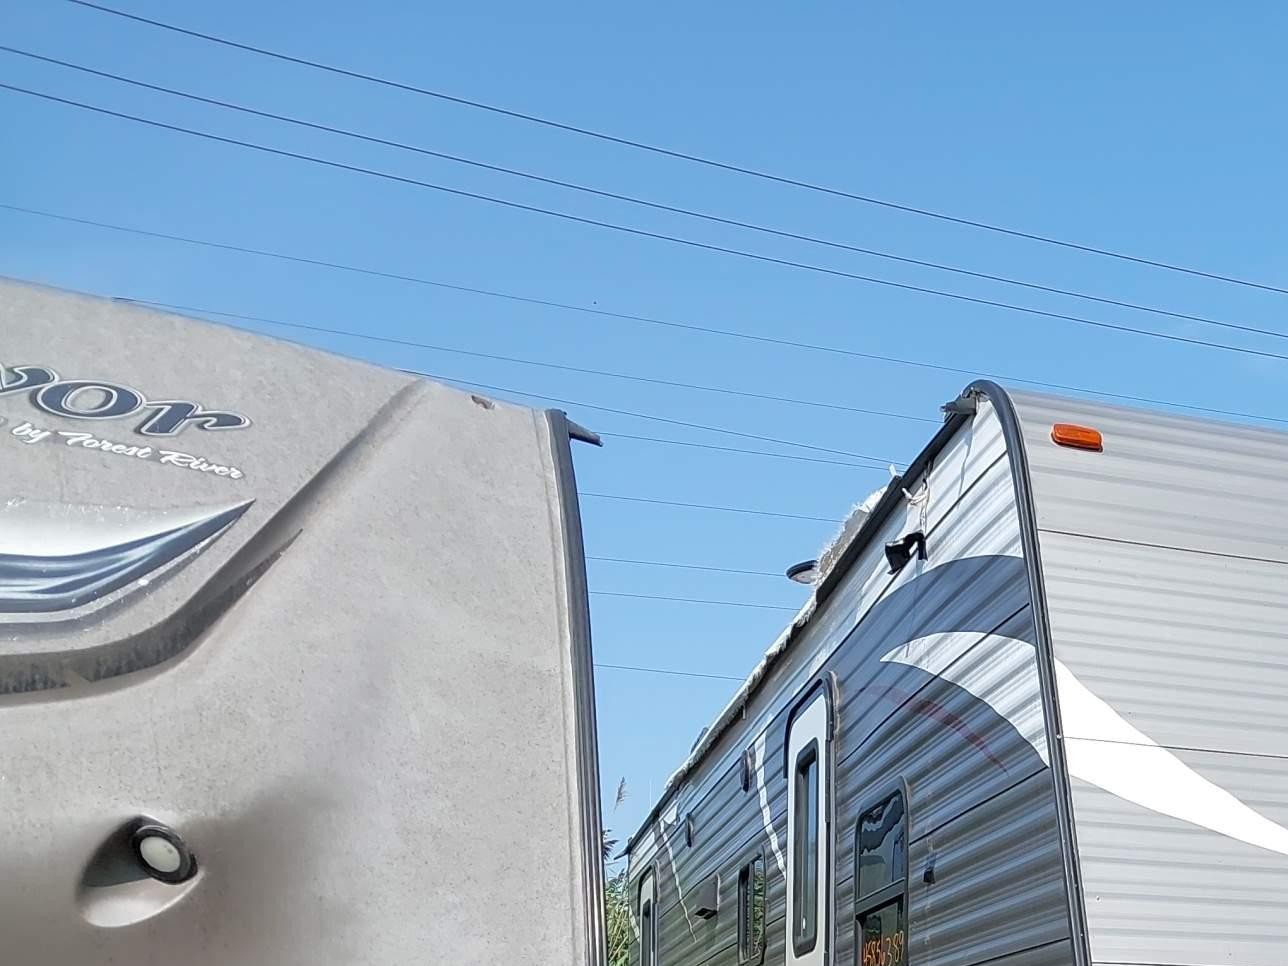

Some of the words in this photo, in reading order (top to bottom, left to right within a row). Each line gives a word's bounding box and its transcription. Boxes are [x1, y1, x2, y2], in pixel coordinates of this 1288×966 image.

[11, 422, 51, 444] by
[57, 430, 152, 459] Forest
[158, 449, 244, 479] River
